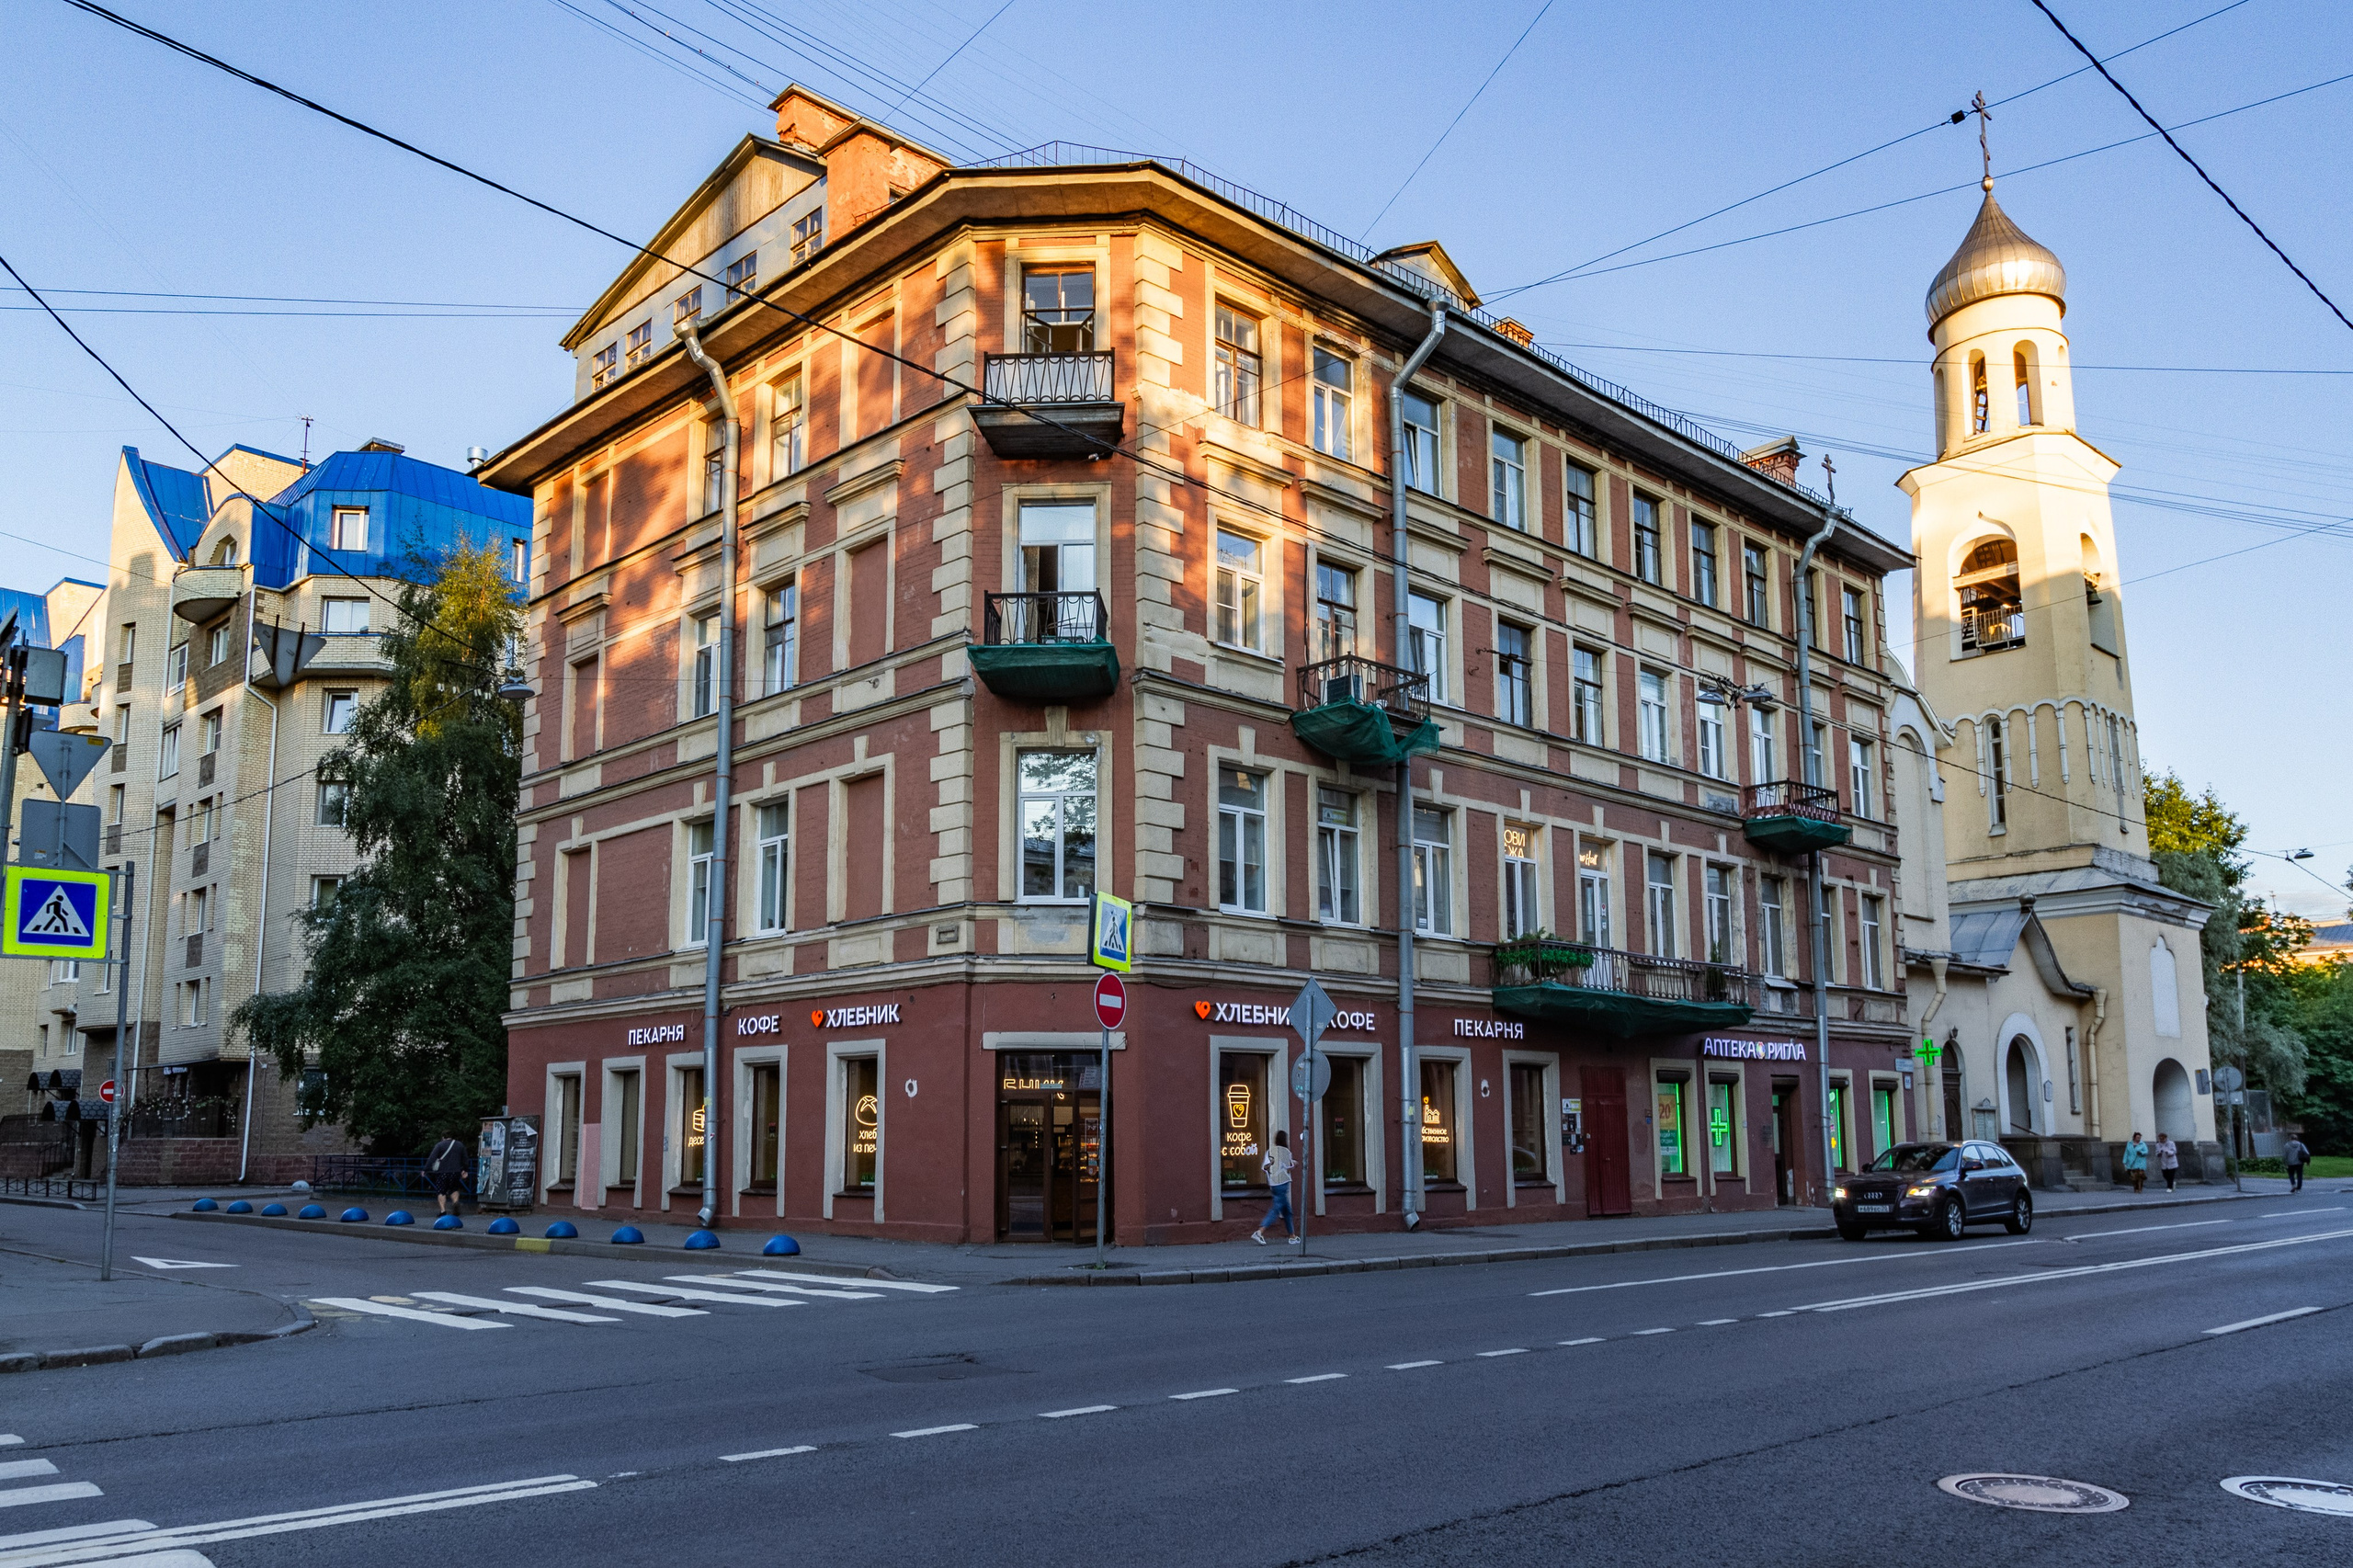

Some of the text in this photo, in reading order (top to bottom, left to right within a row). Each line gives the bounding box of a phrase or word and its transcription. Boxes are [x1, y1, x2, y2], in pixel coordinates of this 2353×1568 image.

[1504, 829, 1526, 847] ОВИ
[826, 1003, 900, 1028] ХЛЕБНИК
[1215, 1002, 1292, 1026] ХЛЕБНИ
[737, 1015, 780, 1036] КОФЕ
[1454, 1018, 1524, 1040] ПЕКАРНЯ
[628, 1024, 685, 1046] ПЕКАРНЯ
[1703, 1037, 1807, 1061] АПТЕКА РИГЛА
[858, 1127, 878, 1140] хлеб
[1226, 1131, 1253, 1145] кофе
[1421, 1126, 1448, 1136] бственное
[688, 1135, 705, 1148] десе
[853, 1143, 878, 1153] из печ
[1230, 1142, 1258, 1156] собой
